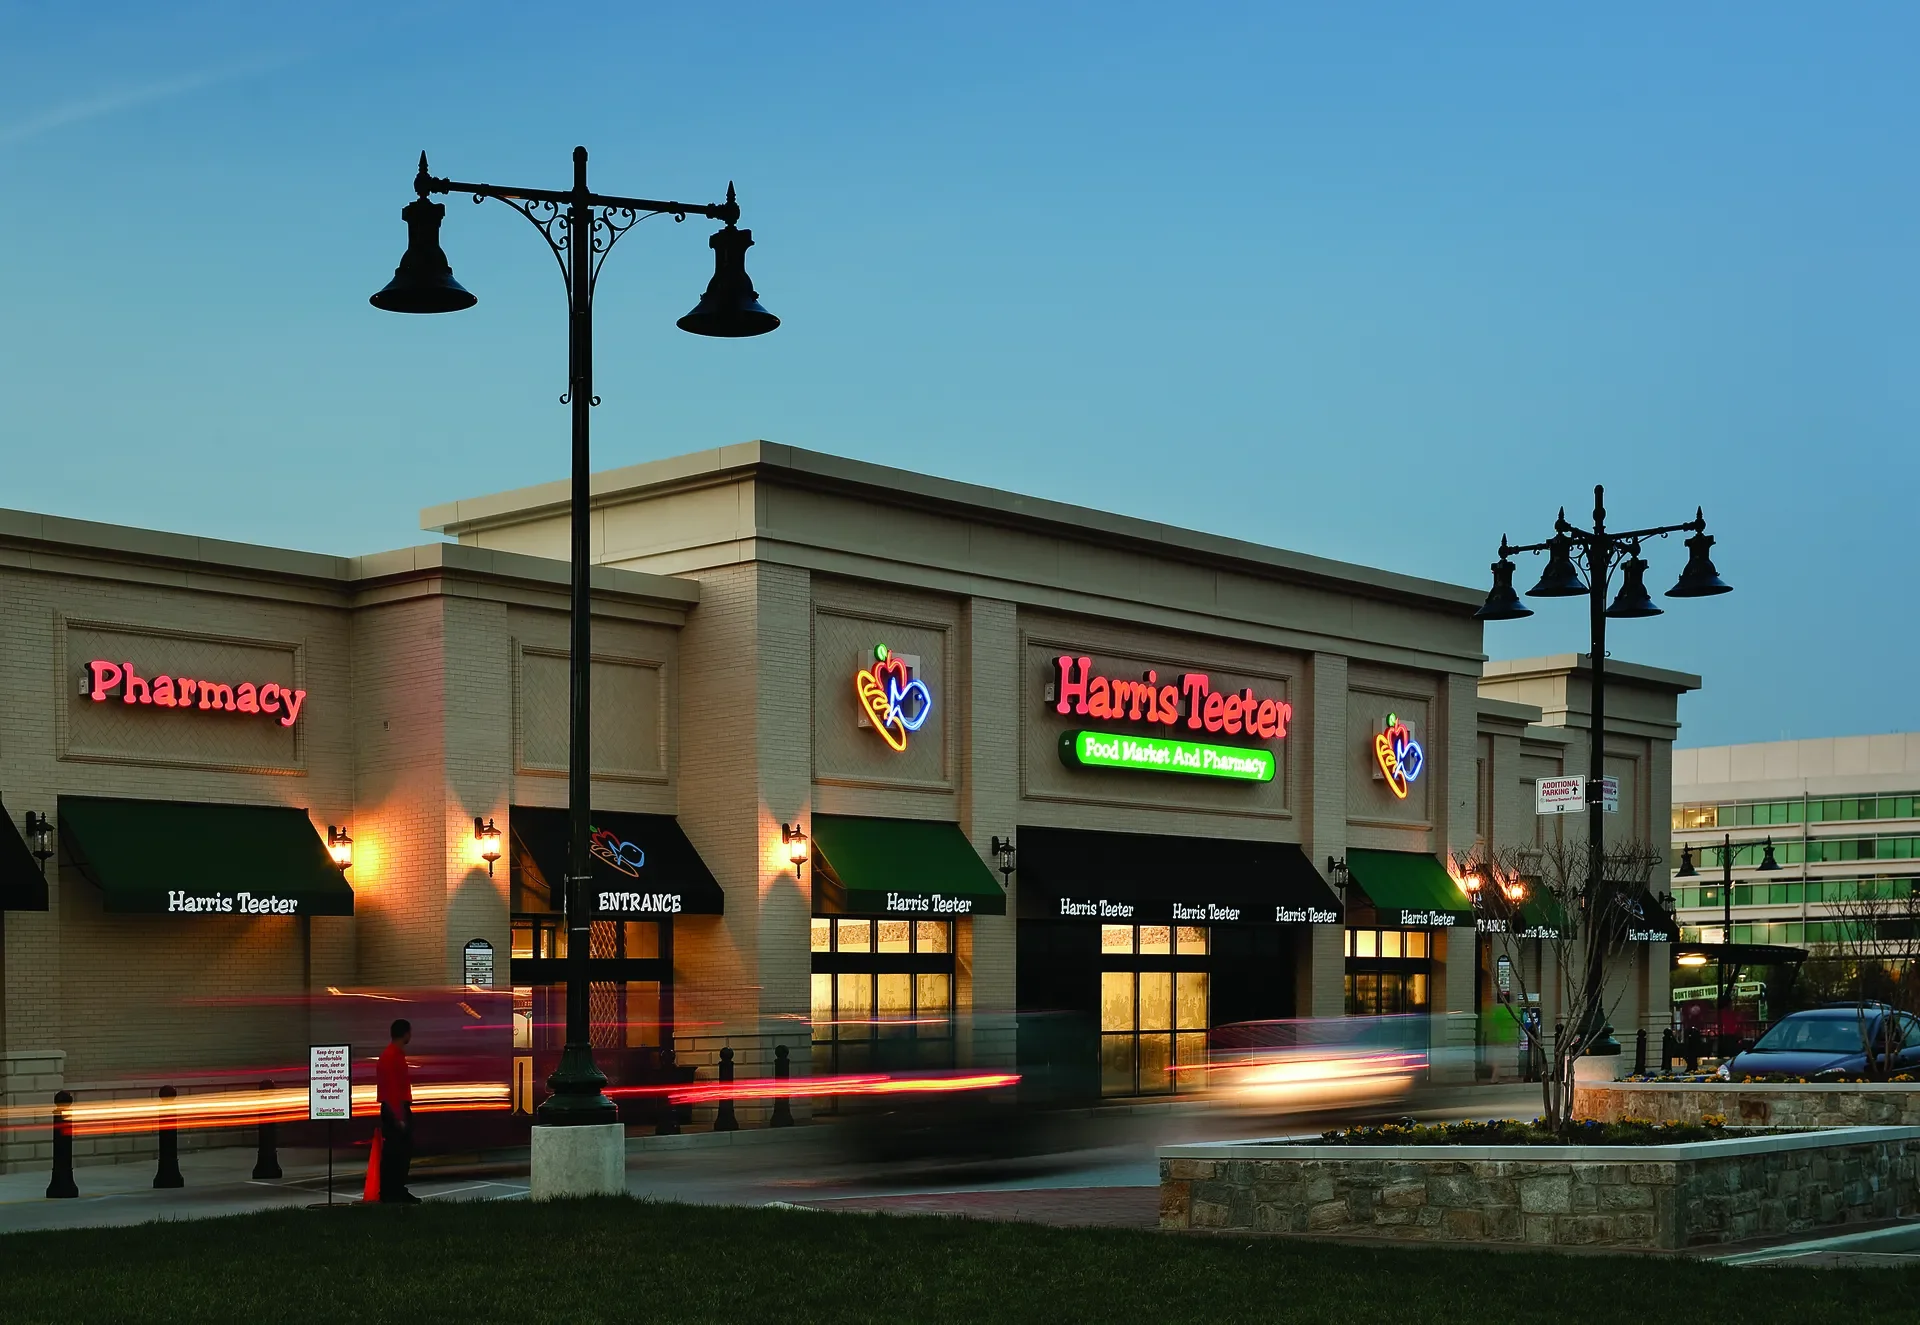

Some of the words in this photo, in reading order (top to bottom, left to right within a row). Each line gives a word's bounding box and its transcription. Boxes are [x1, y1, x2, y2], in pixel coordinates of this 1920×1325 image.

[90, 660, 307, 727] Pharmacy
[1056, 655, 1179, 725] Harris
[1183, 673, 1292, 739] Teeter
[1085, 737, 1119, 761] Food
[1121, 741, 1170, 764] Market
[1173, 746, 1201, 769] And
[1203, 749, 1267, 779] Pharmacy
[1542, 779, 1580, 790] ADDITIONAL
[1542, 788, 1570, 797] PARKING
[168, 890, 233, 912] Harris
[237, 892, 298, 914] Teeter
[598, 892, 682, 913] ENTRANCE
[886, 892, 929, 911] Harris
[931, 894, 972, 913] Teeter
[1060, 898, 1097, 916] Harris
[1099, 899, 1134, 917] Teeter
[1172, 903, 1206, 920] Harris
[1208, 903, 1240, 920] Teeter
[1275, 906, 1306, 922] Harris
[1308, 907, 1337, 923] Teeter
[1400, 909, 1428, 925] Harris
[1429, 911, 1455, 926] Teeter
[1649, 929, 1668, 941] Teeter
